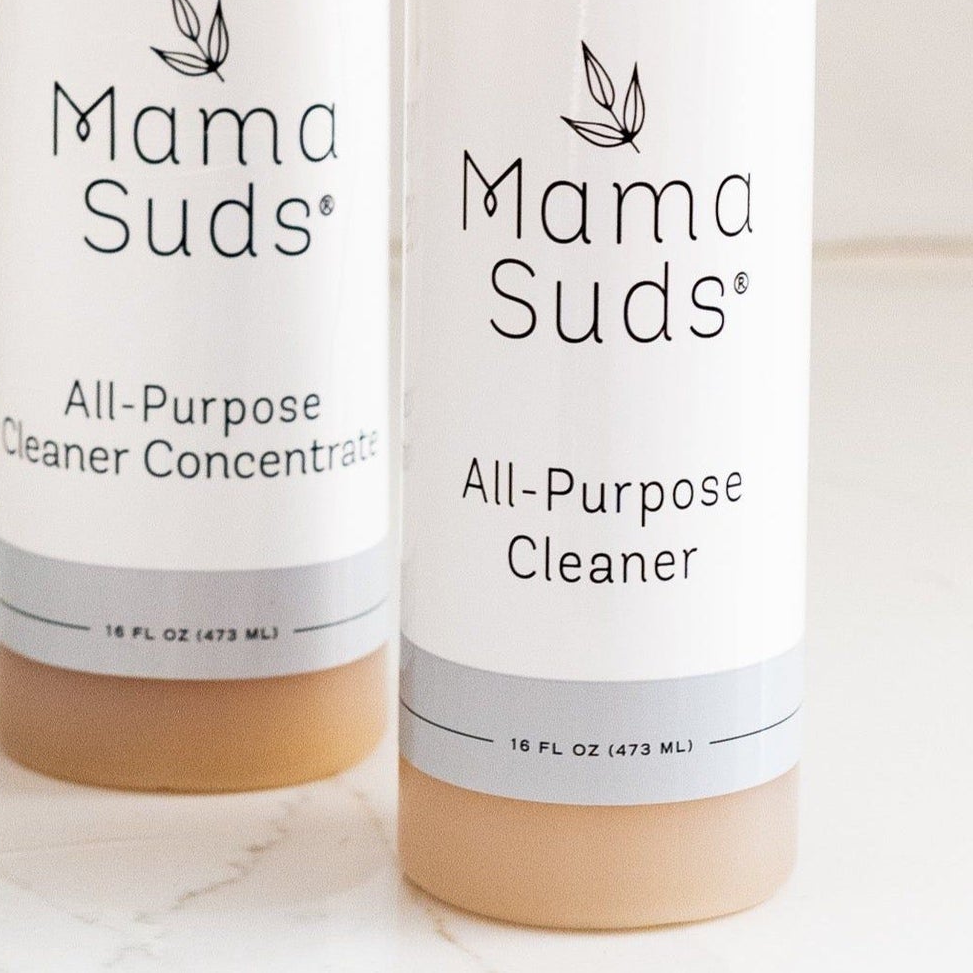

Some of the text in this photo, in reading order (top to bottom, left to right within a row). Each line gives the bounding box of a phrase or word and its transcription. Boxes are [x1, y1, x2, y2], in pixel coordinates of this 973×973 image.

[53, 81, 337, 165] Mama
[463, 149, 753, 244] Mama
[64, 379, 322, 437] All-Purpose
[1, 416, 129, 475] Cleaner
[143, 429, 379, 479] Concentrate
[462, 457, 743, 527] All-Purpose
[507, 534, 698, 584] Cleaner
[106, 624, 278, 642] 16 FL OZ (473 ML)
[511, 738, 694, 758] 16 FL OZ (473 ML)
